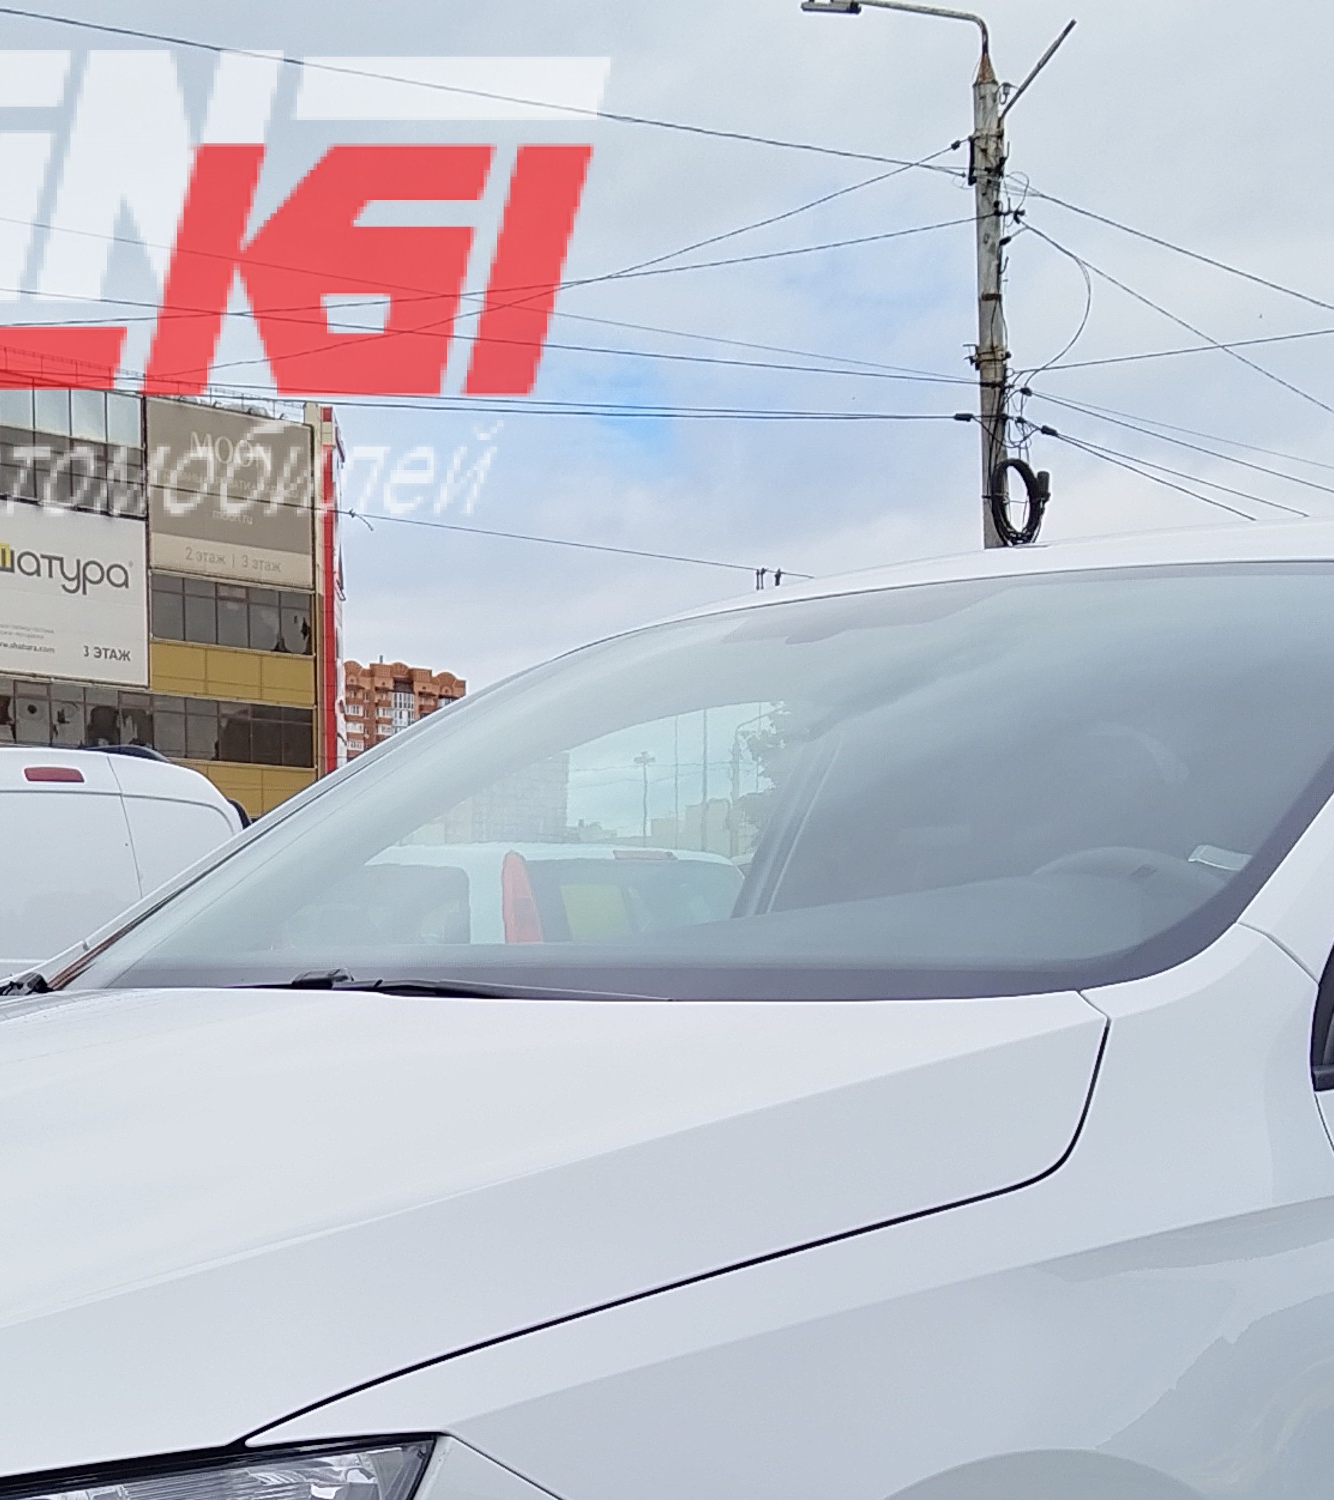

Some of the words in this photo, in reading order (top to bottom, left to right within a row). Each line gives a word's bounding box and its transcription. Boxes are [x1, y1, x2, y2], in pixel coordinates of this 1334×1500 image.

[185, 546, 193, 561] 2
[195, 550, 227, 566] этаж
[241, 554, 250, 568] 3
[252, 558, 282, 573] этаж
[83, 645, 91, 658] 3
[93, 646, 132, 662] ЭТАЖ
